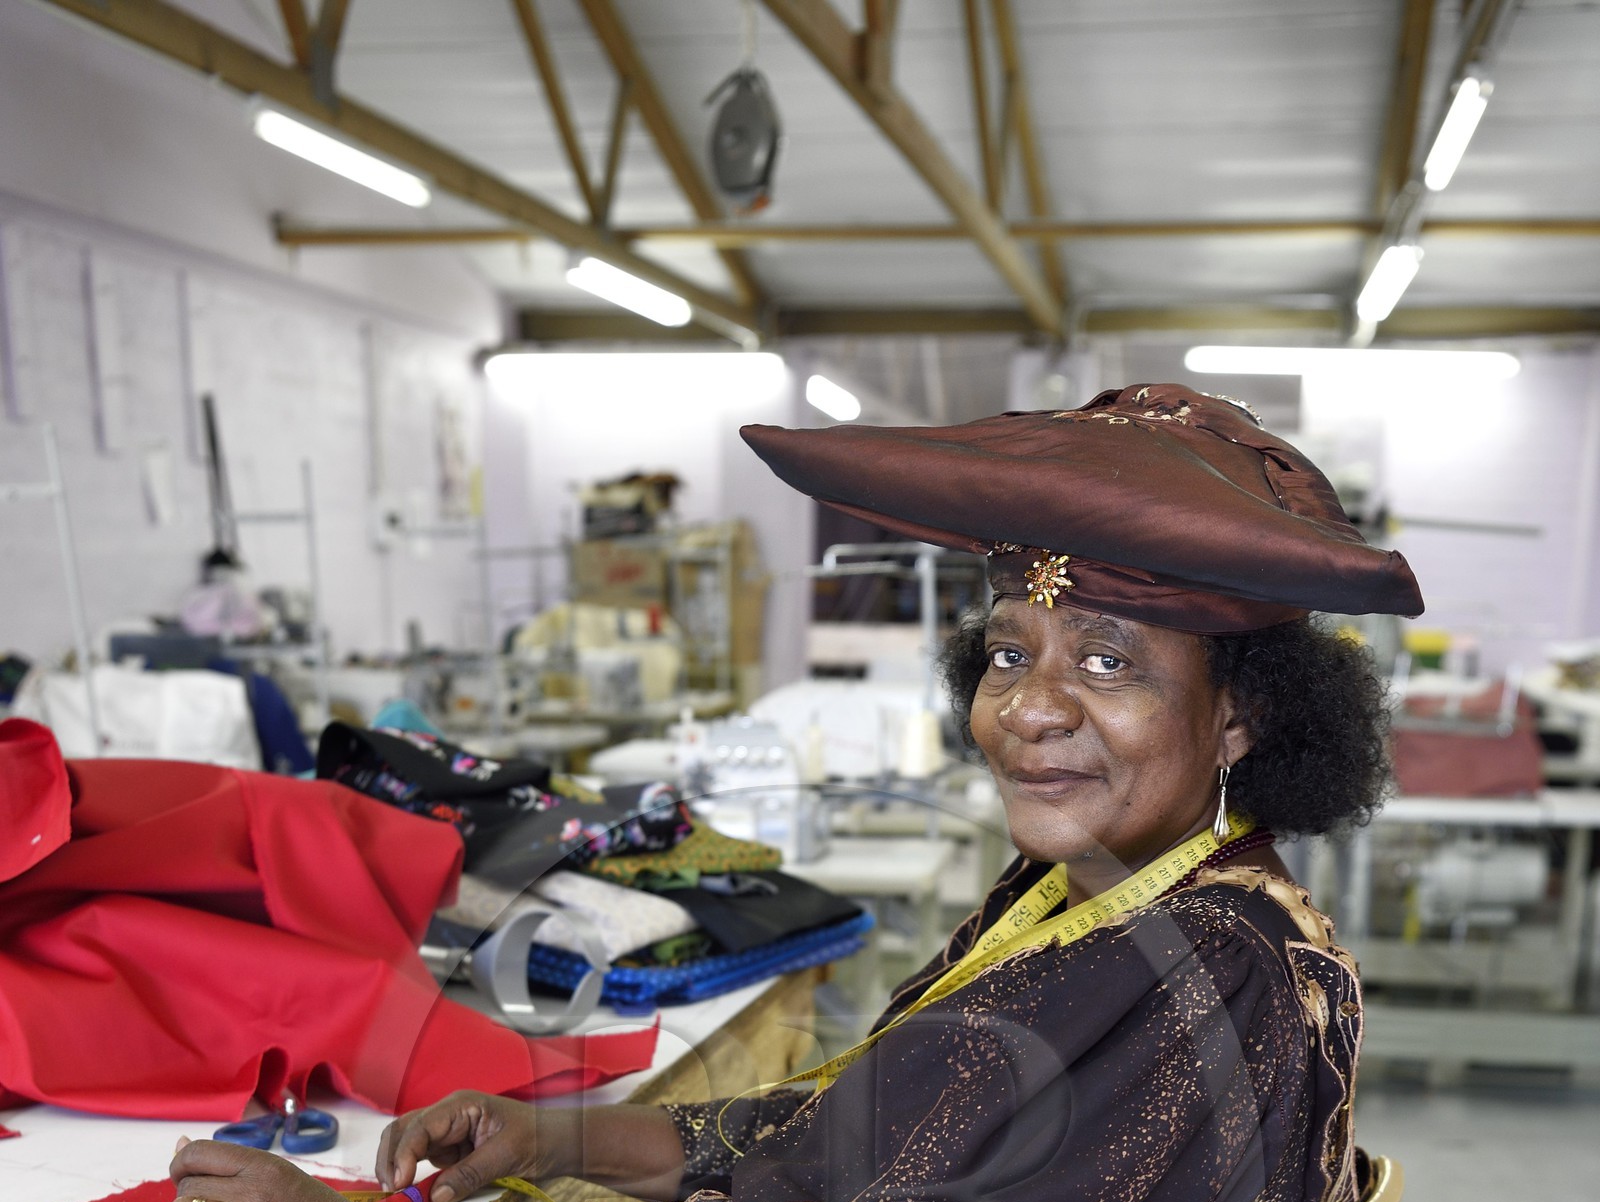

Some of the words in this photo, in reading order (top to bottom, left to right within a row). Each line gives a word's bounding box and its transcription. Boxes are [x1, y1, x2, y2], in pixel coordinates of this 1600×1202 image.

[1200, 839, 1213, 853] 214
[1186, 848, 1200, 862] 215
[1172, 857, 1186, 872] 216
[1158, 867, 1172, 880] 217
[1038, 880, 1059, 900] 51
[1144, 876, 1158, 890] 218
[1130, 885, 1144, 899] 219
[1116, 894, 1130, 907] 220
[1103, 902, 1116, 915] 221
[1008, 905, 1032, 927] 52
[1090, 910, 1103, 923] 222
[1064, 924, 1076, 937] 224
[1077, 917, 1090, 930] 223
